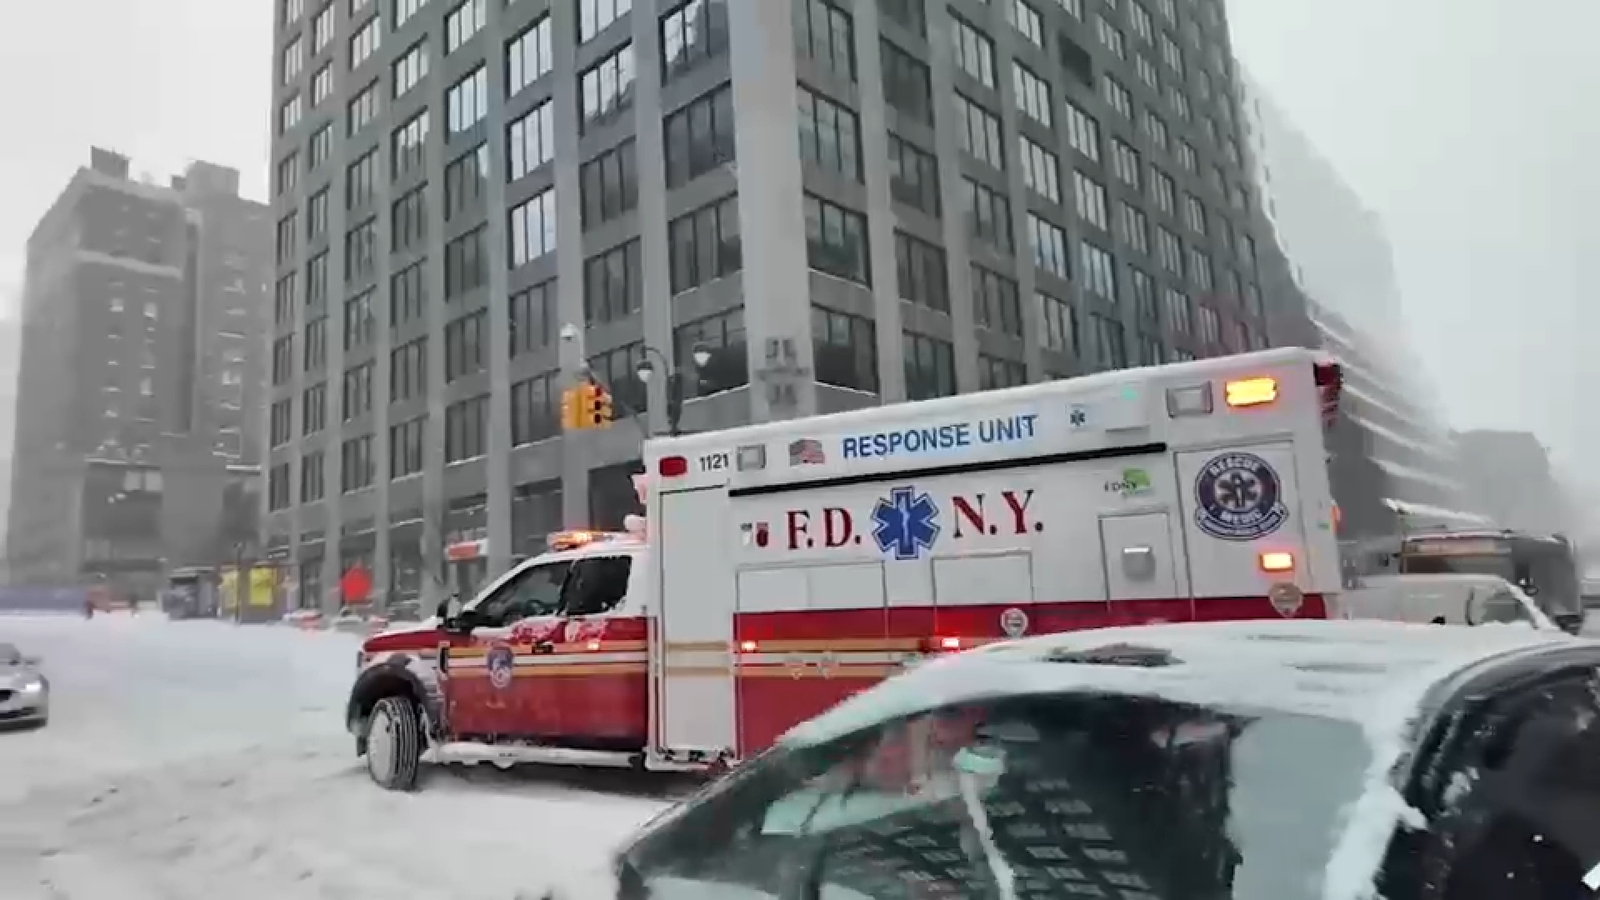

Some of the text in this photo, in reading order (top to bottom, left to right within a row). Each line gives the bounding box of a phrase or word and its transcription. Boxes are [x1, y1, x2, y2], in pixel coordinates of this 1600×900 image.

[843, 414, 1039, 458] RESPONSE UNIT
[699, 453, 729, 472] 1121
[786, 489, 1044, 550] F.D. N.Y.
